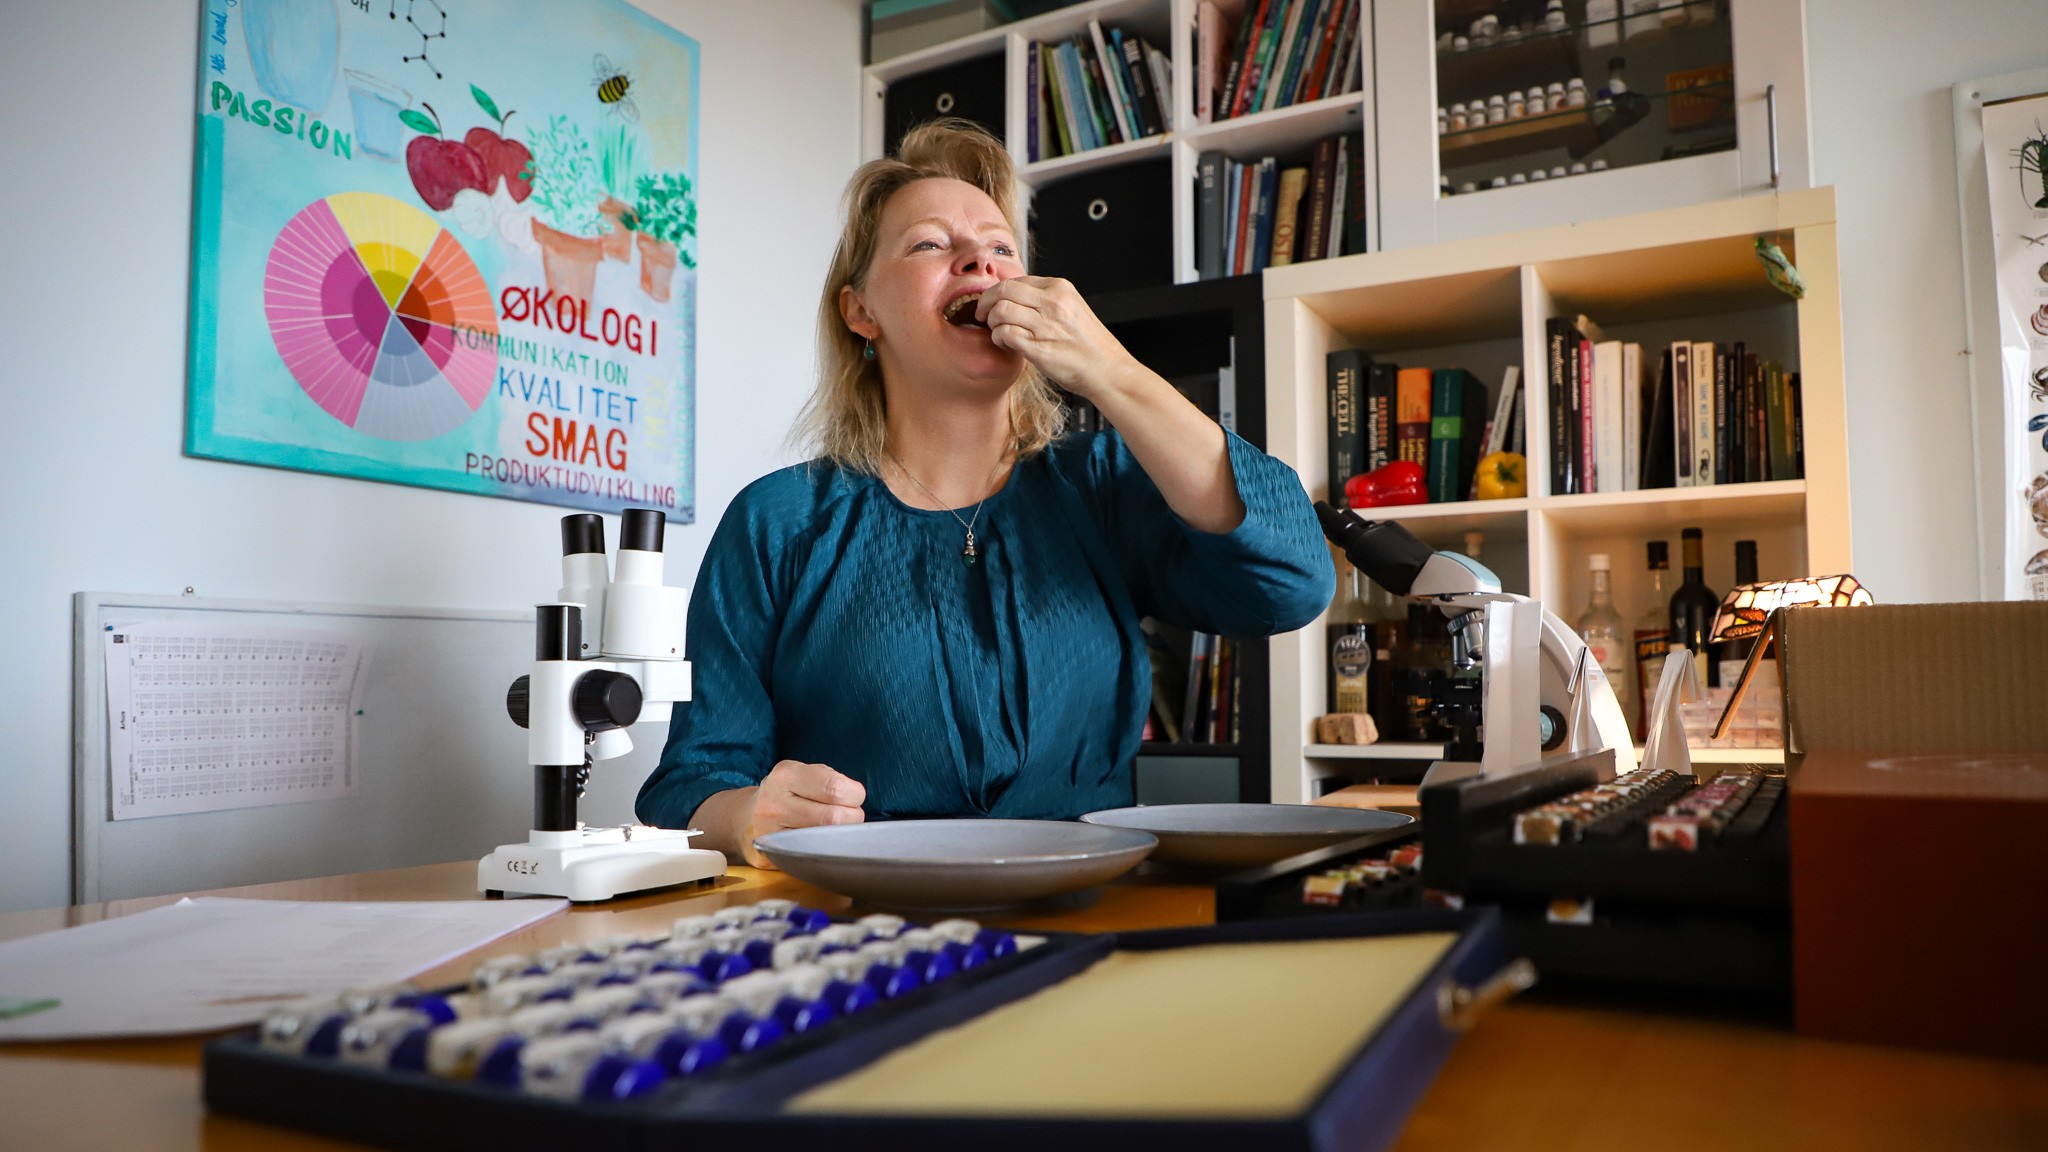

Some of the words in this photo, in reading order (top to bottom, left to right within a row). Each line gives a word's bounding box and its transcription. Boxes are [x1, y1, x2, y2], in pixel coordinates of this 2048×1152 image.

[211, 81, 352, 160] PASSION
[1274, 223, 1293, 260] OST
[501, 285, 658, 357] ØKOLOGI
[450, 321, 629, 387] KOMMUNIKATION
[500, 366, 638, 425] KVALITET
[1337, 368, 1349, 400] THE
[525, 411, 629, 472] SMAG
[1336, 400, 1349, 437] CELL
[466, 452, 676, 510] PRODUKTUDVIKLING
